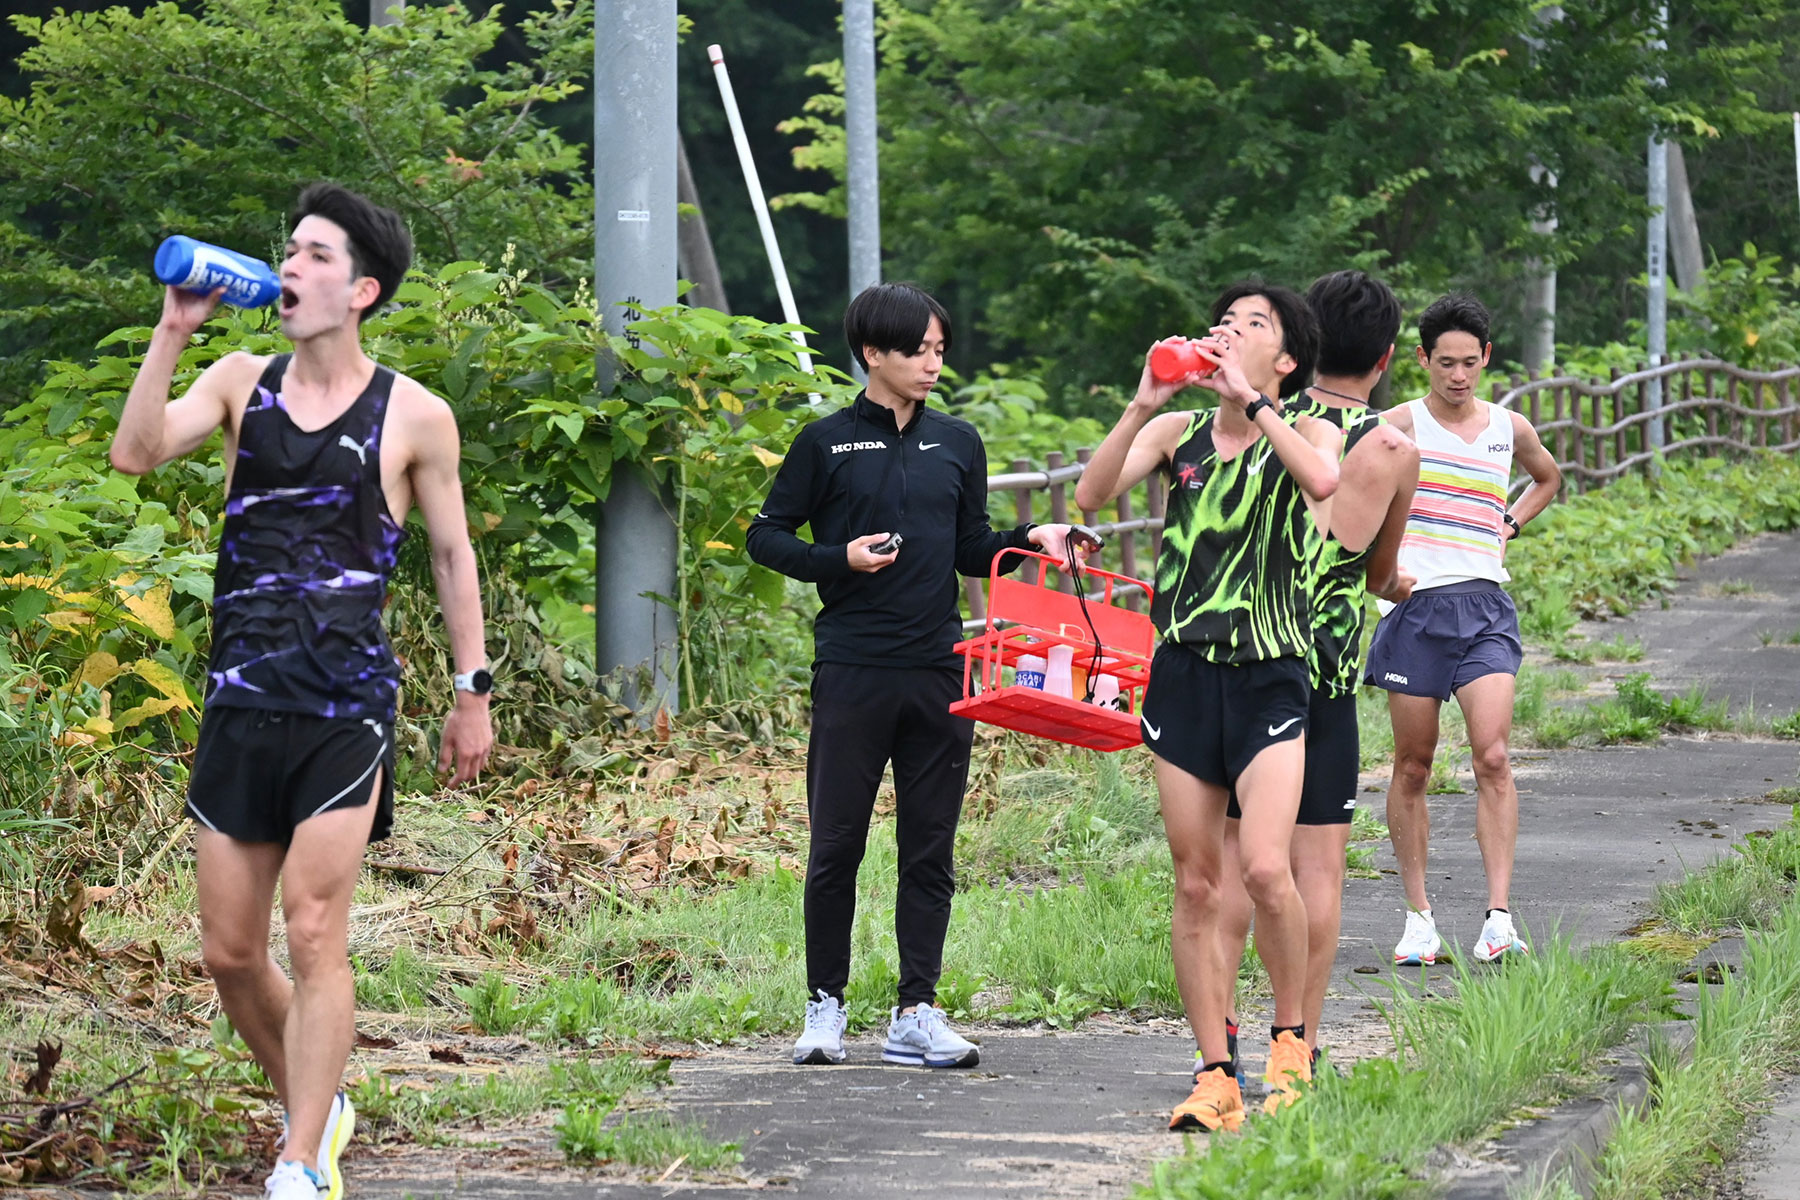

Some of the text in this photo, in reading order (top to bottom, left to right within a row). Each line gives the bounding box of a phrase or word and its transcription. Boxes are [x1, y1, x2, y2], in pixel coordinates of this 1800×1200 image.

[831, 441, 887, 454] HONDA
[1488, 444, 1510, 453] HOKA
[1016, 674, 1042, 682] OCARI
[1384, 672, 1408, 685] HOKA
